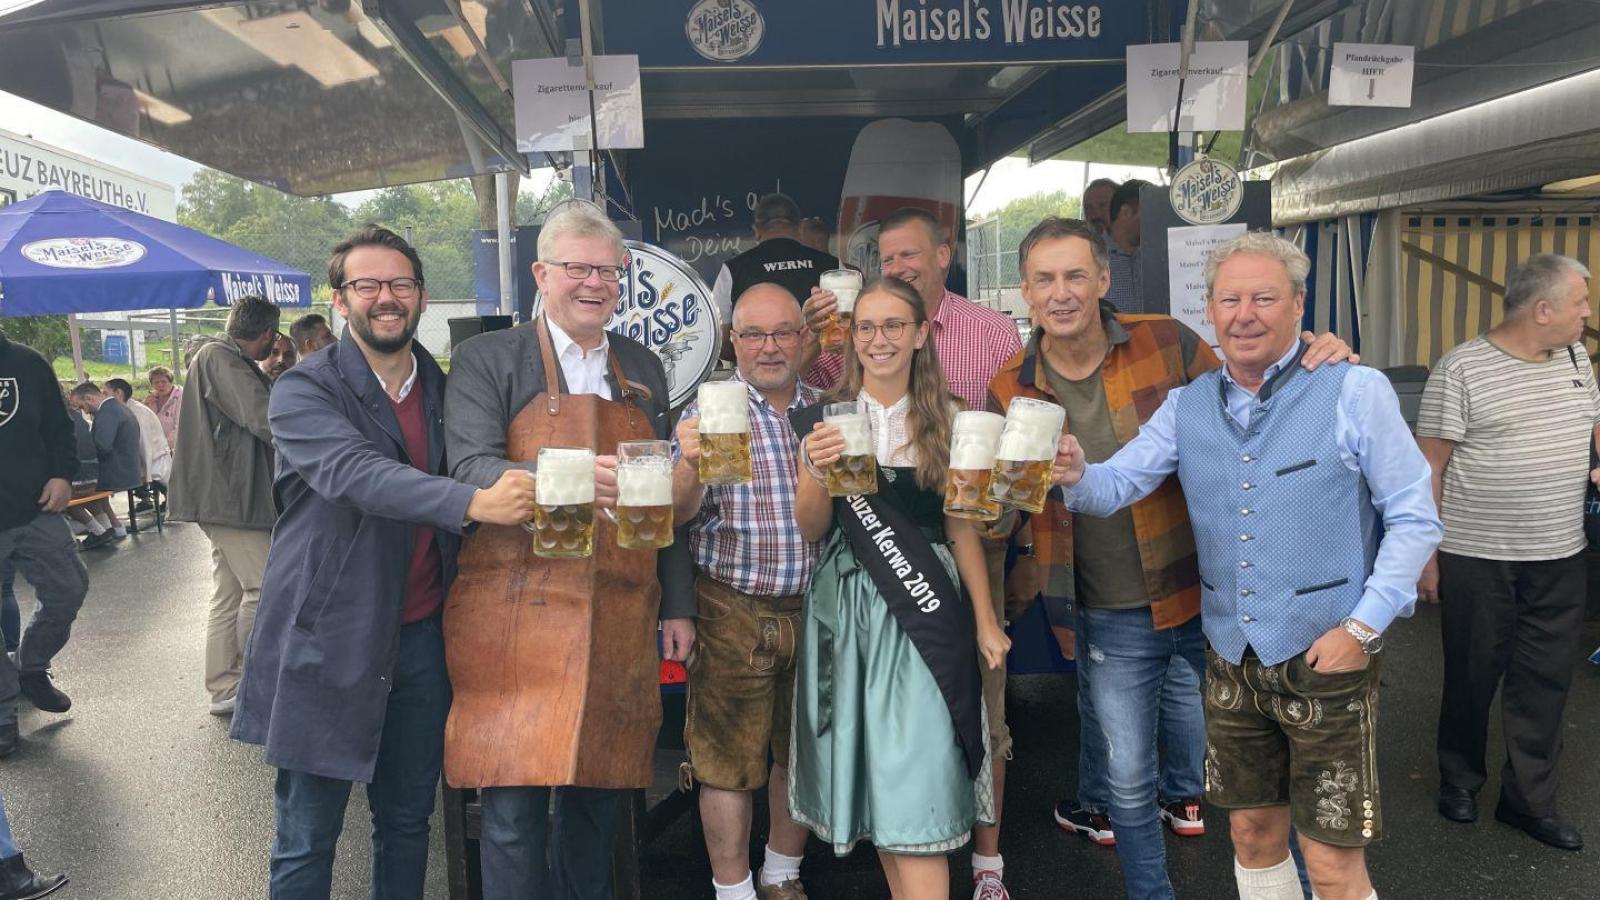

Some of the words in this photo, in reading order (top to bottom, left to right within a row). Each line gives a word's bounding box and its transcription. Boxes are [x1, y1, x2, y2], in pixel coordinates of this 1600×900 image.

[717, 12, 757, 46] Weisse
[876, 0, 991, 48] Maisel's
[1001, 0, 1101, 43] Weisse
[1151, 66, 1223, 78] Zigaretnverkauf
[1346, 53, 1404, 63] Pfandrückgabe
[1362, 67, 1385, 76] HIER
[537, 82, 613, 95] Zigarettenvkauf
[37, 159, 123, 207] BAYREUTH
[1199, 177, 1237, 210] Weisse
[654, 195, 734, 242] Mach's
[78, 243, 132, 263] Weisse
[763, 259, 814, 272] WERNI
[221, 272, 263, 305] Maisel's
[262, 274, 300, 304] Weisse
[871, 526, 913, 579] Kerwa
[903, 571, 941, 613] 2019
